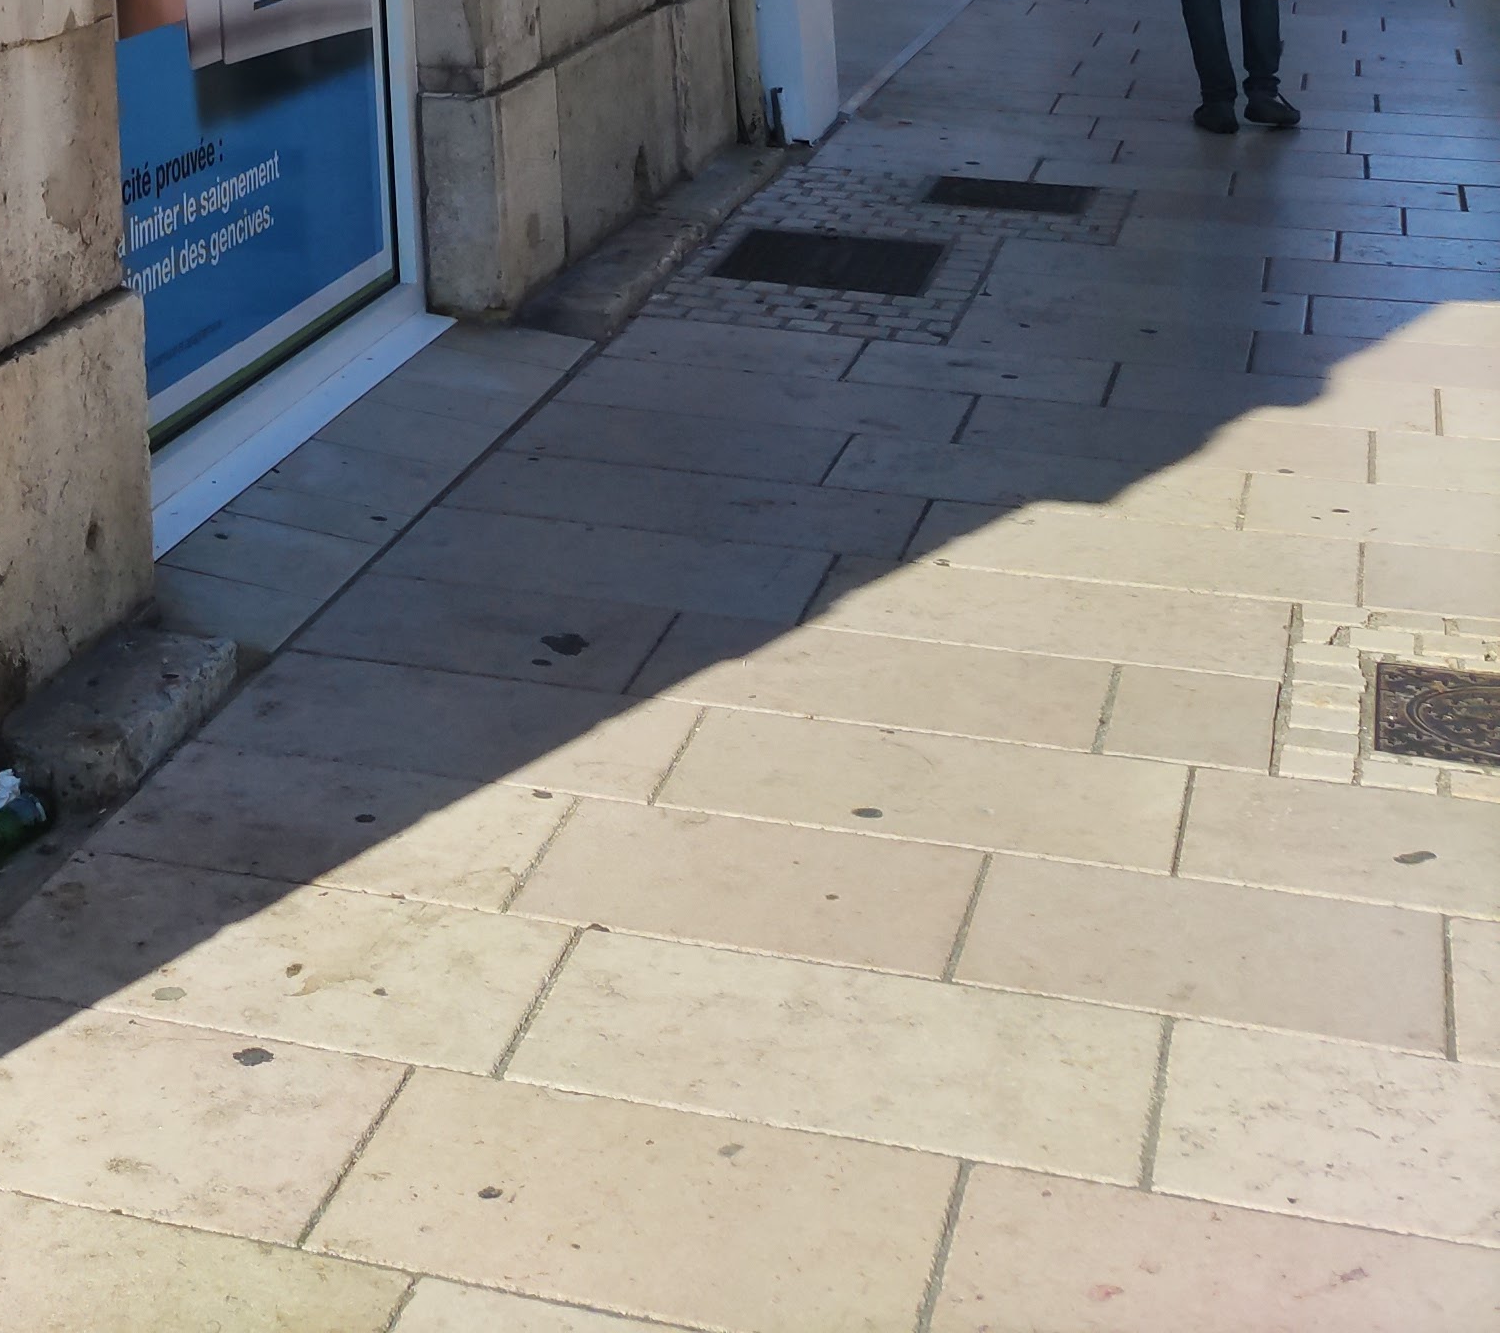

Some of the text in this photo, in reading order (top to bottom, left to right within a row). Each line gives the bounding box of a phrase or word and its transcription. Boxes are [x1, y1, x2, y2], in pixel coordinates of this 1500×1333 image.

[122, 161, 151, 206] cité
[156, 137, 215, 199] prouvée
[130, 202, 180, 253] limiter
[183, 192, 197, 226] le
[199, 150, 280, 216] saignement
[179, 236, 206, 276] des
[210, 204, 275, 267] gencives.
